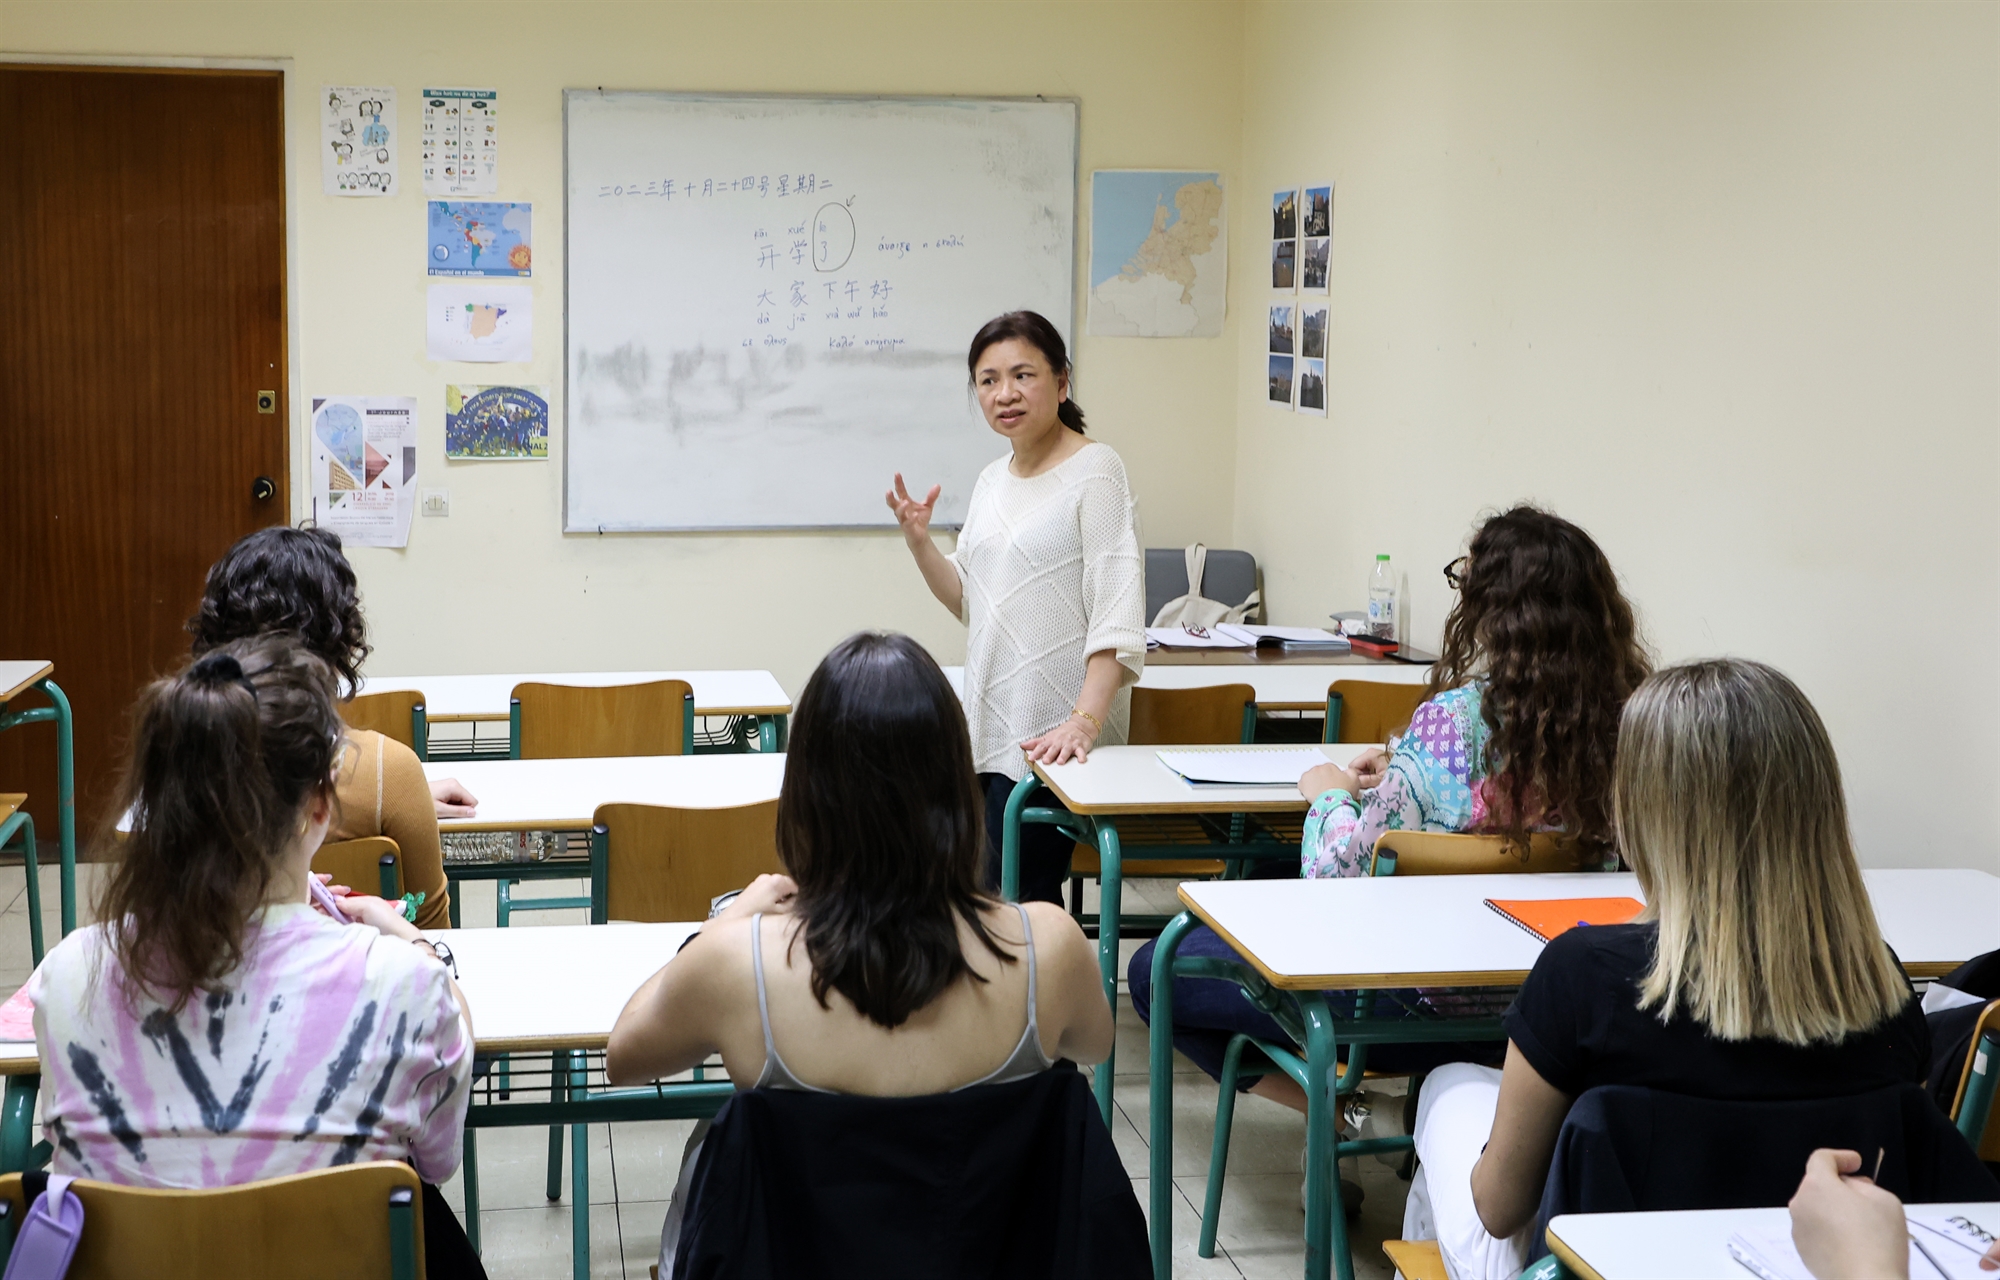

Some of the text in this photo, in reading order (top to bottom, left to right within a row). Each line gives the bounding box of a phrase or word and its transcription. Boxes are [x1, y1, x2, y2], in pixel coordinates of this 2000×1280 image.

[787, 220, 807, 236] xué
[757, 279, 894, 308] 大家下午好
[757, 311, 771, 325] dà
[352, 491, 363, 502] 12
